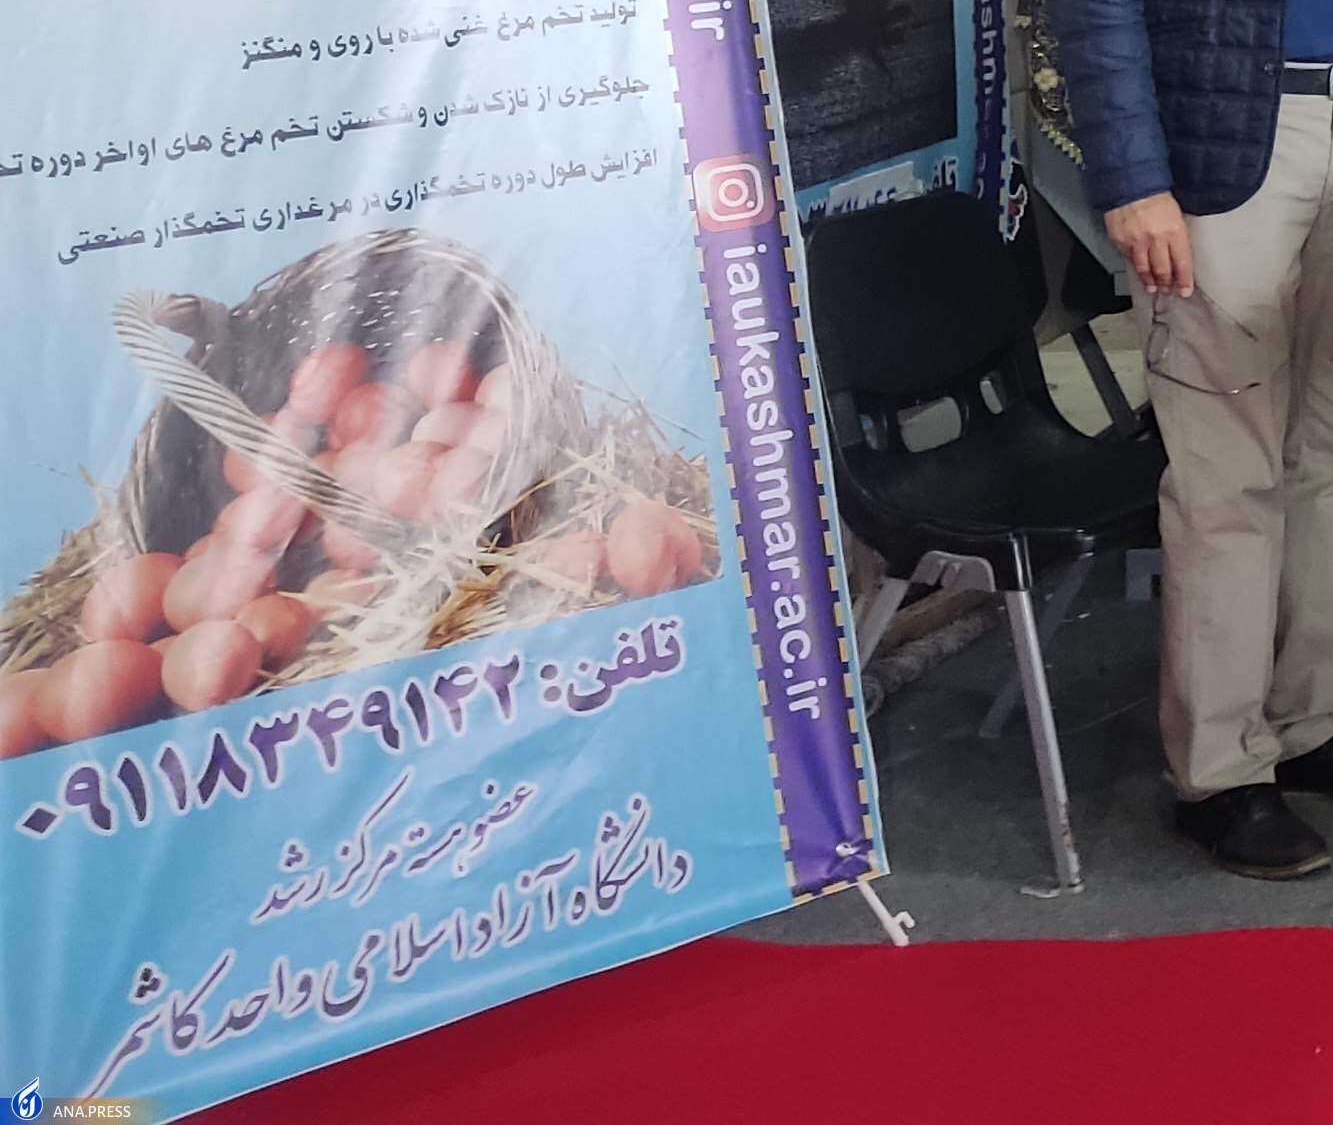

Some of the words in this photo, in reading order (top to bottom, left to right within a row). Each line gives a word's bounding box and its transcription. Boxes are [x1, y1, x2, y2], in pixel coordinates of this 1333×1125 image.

[445, 14, 487, 47] غنی
[497, 11, 534, 40] مرغ
[542, 4, 584, 35] تخم
[590, 0, 637, 27] تولید
[241, 36, 302, 69] منگنز
[327, 35, 373, 57] روی
[483, 89, 529, 115] نازک
[558, 75, 650, 108] جلوگیری
[327, 103, 413, 141] شکستن
[434, 93, 479, 126] شدن
[165, 131, 213, 161] های
[220, 126, 263, 157] مرغ
[270, 115, 319, 150] تخم
[31, 150, 86, 178] دوره
[93, 137, 156, 173] اواخر
[591, 148, 657, 181] افزایش
[491, 169, 536, 195] دوره
[541, 160, 586, 189] طول
[252, 196, 351, 232] مرغداری
[58, 226, 146, 265] صنعتی
[724, 243, 828, 720] iaukashmar.ac.ir
[541, 618, 683, 713] تلفن:
[19, 652, 521, 836] ۰۹۱۱۸۳۴۹۱۴۲
[469, 783, 535, 852] عضو
[332, 771, 411, 902] مرکز
[571, 795, 692, 923] دانشگاه
[255, 844, 325, 921] رشد
[471, 853, 577, 955] آزاد
[322, 910, 466, 1019] اسلامی
[205, 958, 313, 1048] واحد
[84, 949, 232, 1105] کاشمر
